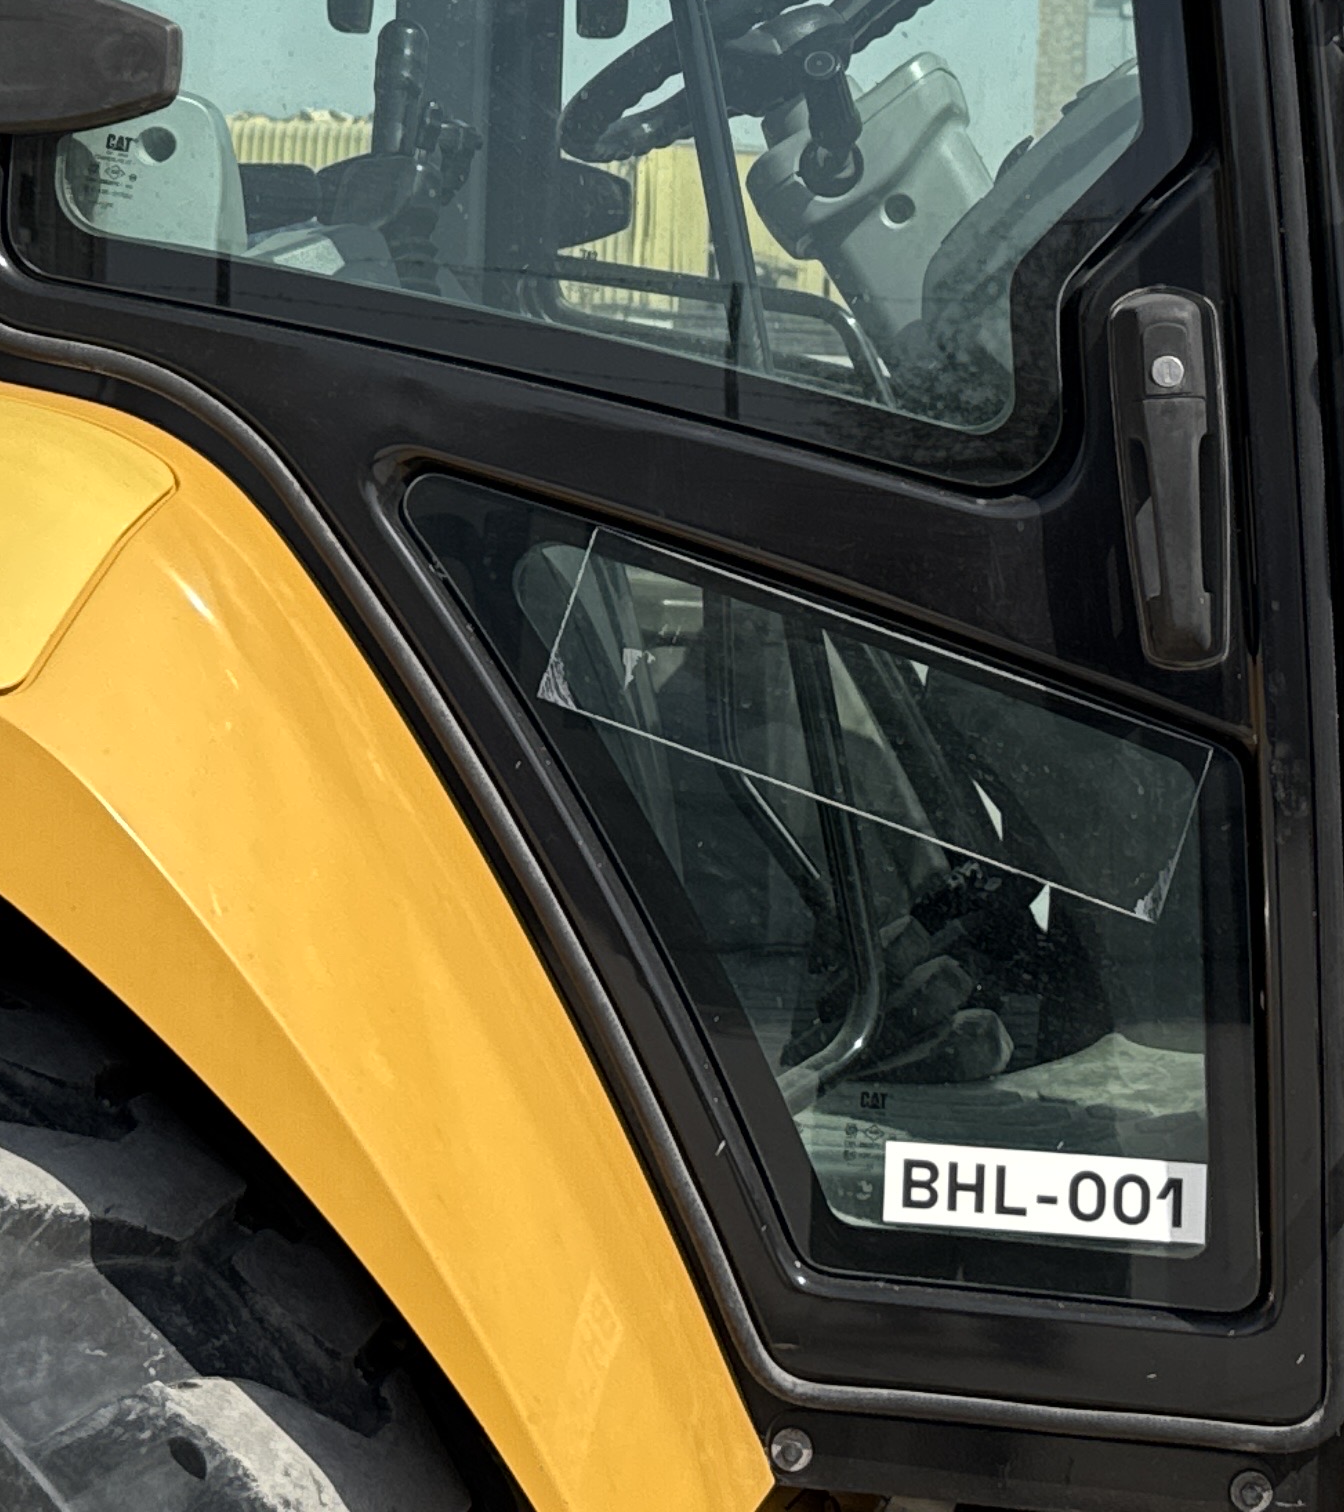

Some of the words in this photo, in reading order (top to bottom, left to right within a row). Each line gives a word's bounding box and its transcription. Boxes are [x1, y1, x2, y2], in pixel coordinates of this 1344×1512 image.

[105, 133, 133, 152] CAT
[860, 1091, 888, 1110] CAT
[901, 1158, 1183, 1229] BHL-001
